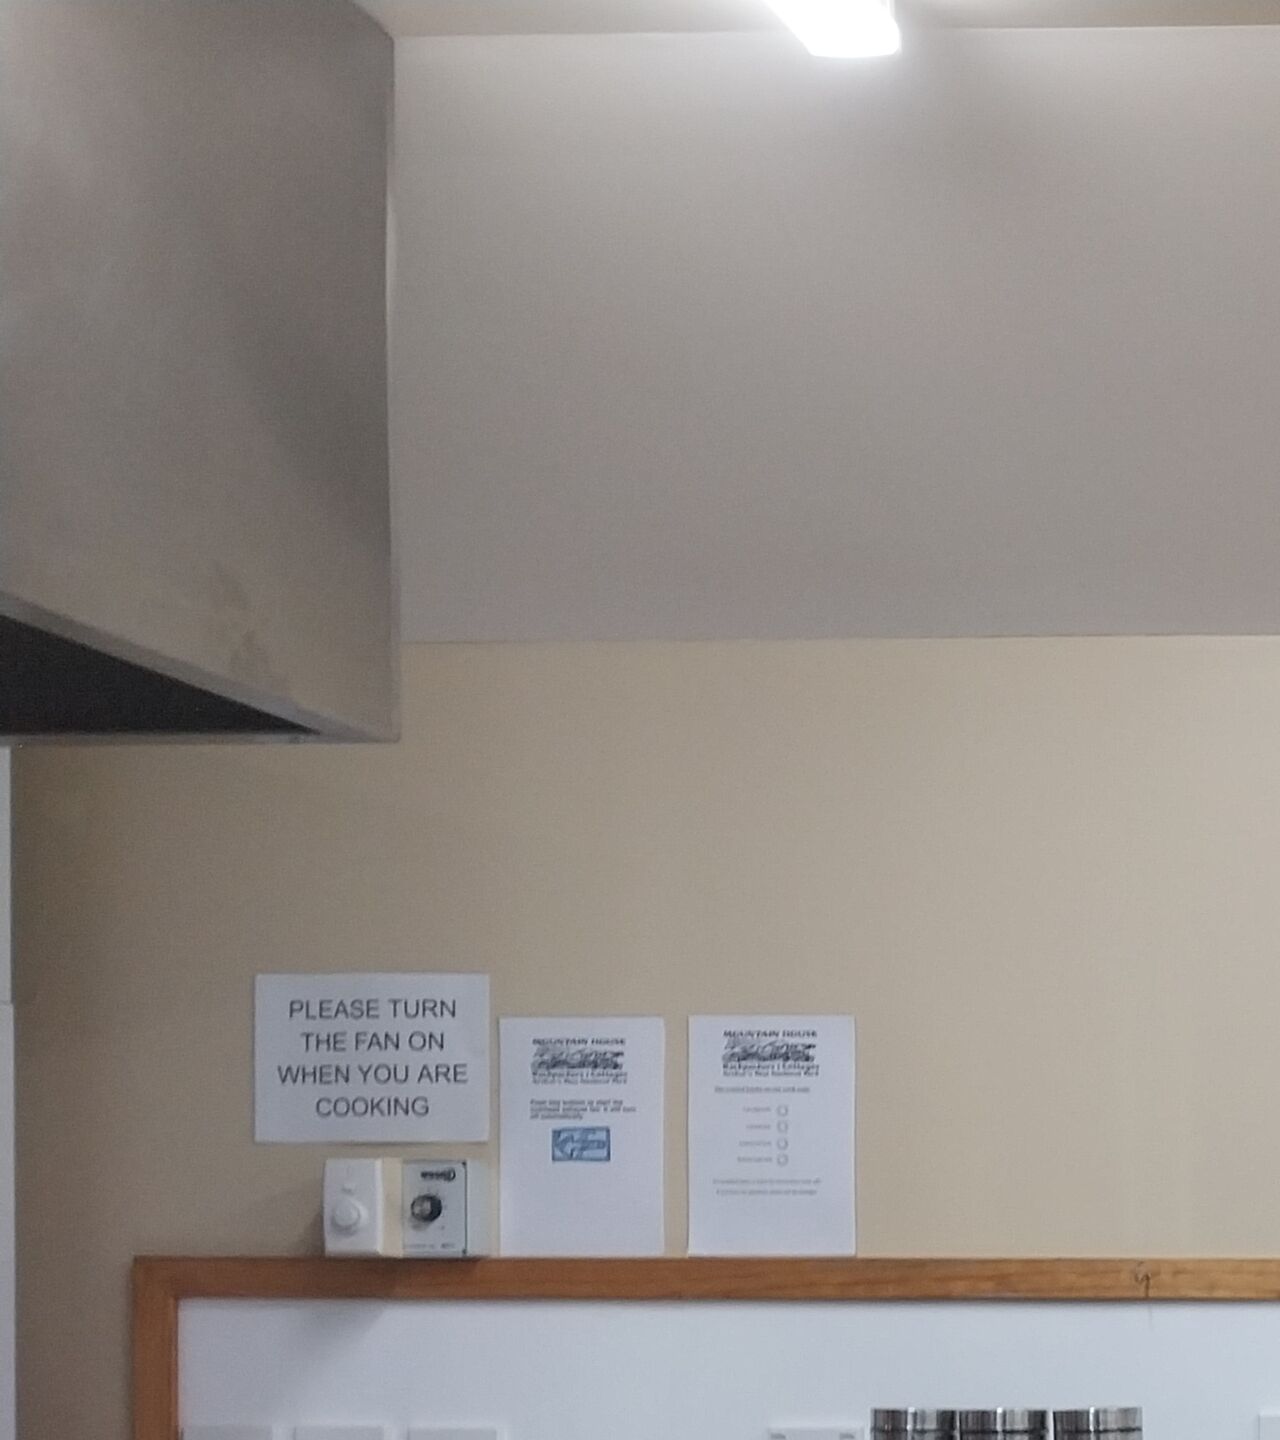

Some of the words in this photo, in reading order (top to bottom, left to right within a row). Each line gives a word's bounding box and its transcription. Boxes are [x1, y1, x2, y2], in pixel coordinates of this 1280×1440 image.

[289, 999, 380, 1020] PLEASE
[390, 999, 456, 1019] TURN
[301, 1032, 347, 1052] THE
[355, 1031, 399, 1051] FAN
[408, 1031, 444, 1051] ON
[278, 1064, 350, 1085] WHEN
[358, 1064, 409, 1084] YOU
[417, 1063, 468, 1084] ARE
[316, 1096, 429, 1117] COOKING
